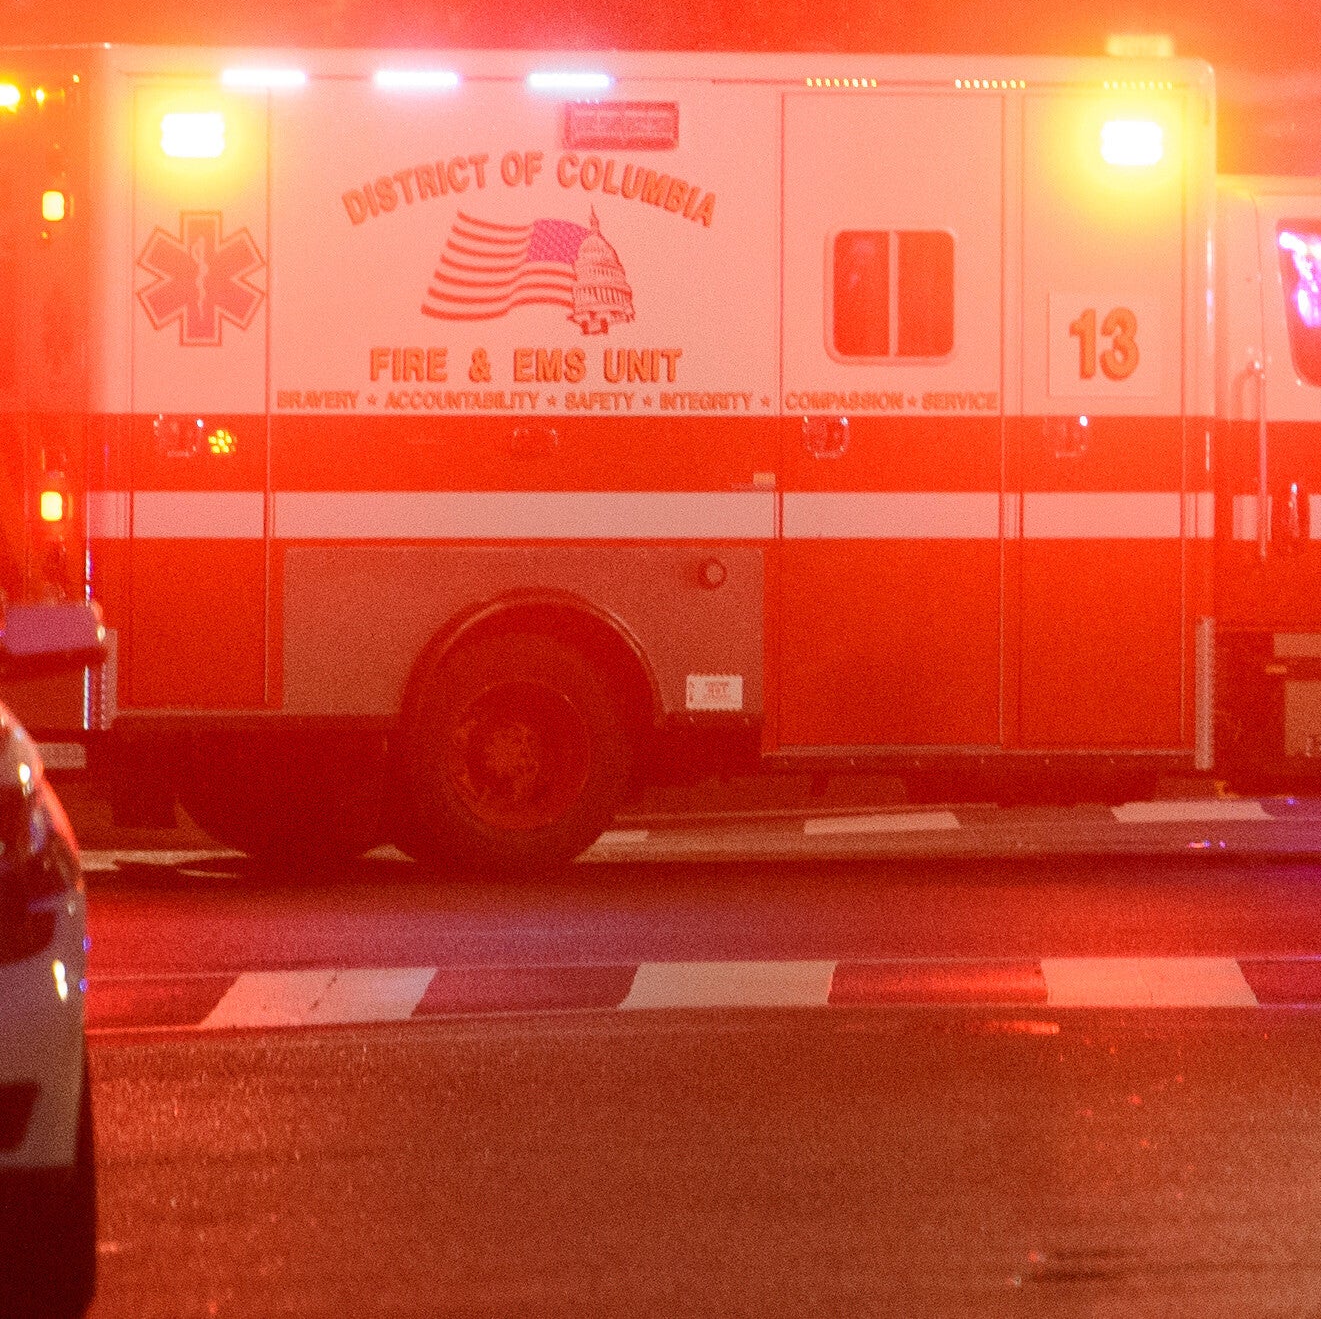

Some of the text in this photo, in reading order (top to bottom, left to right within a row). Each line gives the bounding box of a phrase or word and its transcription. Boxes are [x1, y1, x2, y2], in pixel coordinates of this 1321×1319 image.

[341, 151, 717, 228] DISTRICT OF COLUMBIA
[369, 347, 683, 383] FIRE & EMS UNIT
[1069, 307, 1139, 381] 13
[276, 390, 998, 411] BRAVERY ACCOUNTABILITY SAFETY INTEGRITY COMPASSION SERVICE
